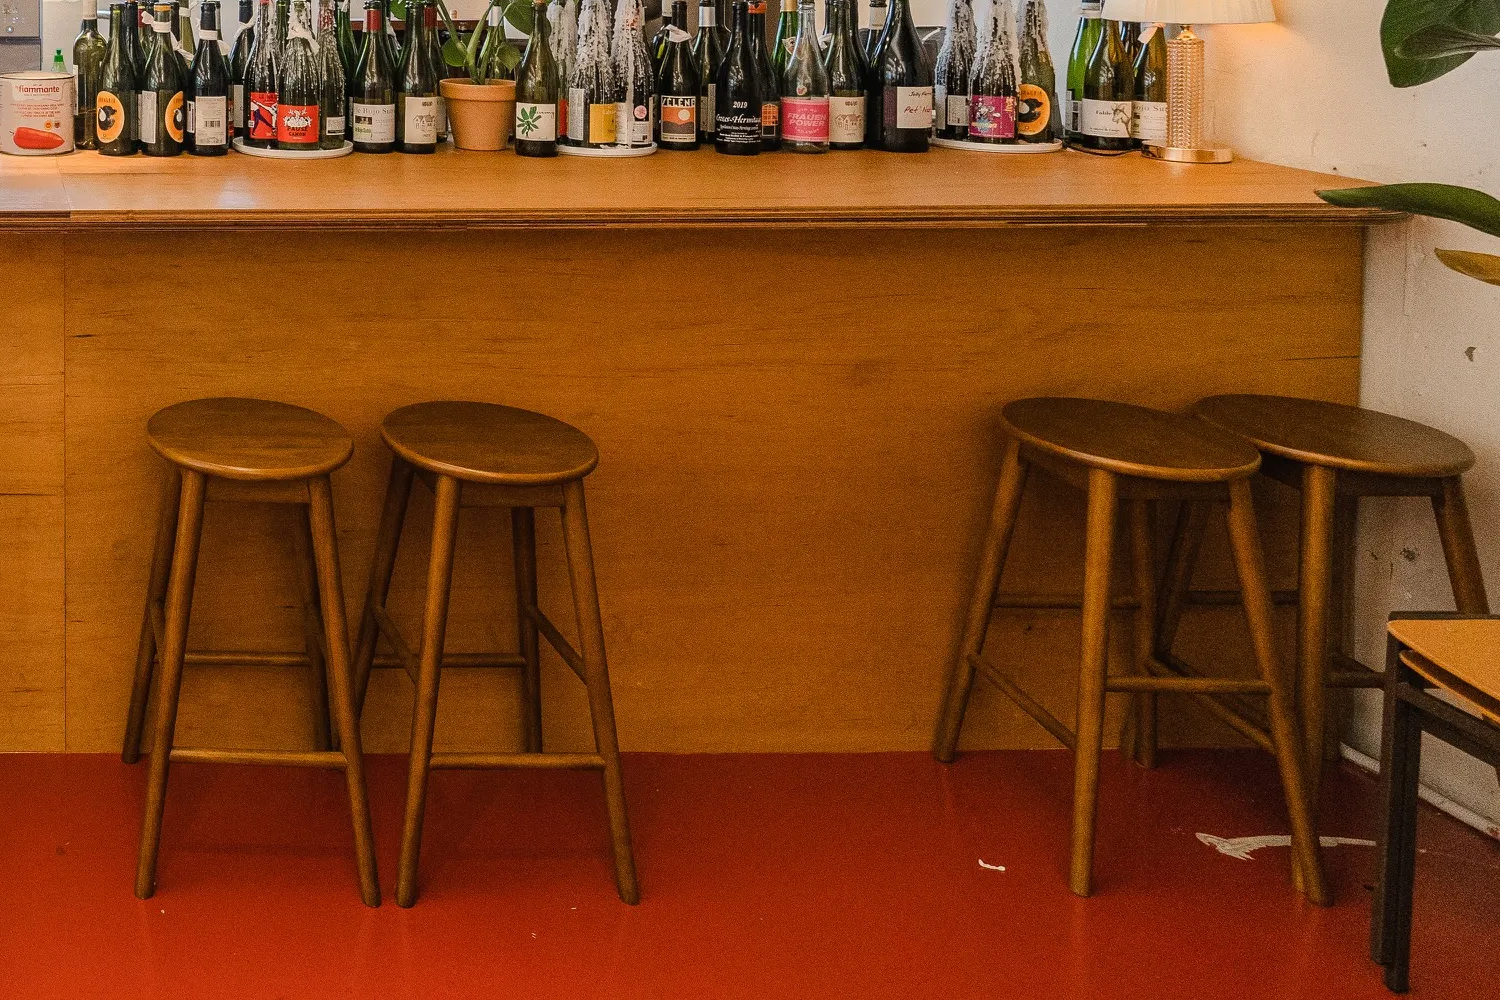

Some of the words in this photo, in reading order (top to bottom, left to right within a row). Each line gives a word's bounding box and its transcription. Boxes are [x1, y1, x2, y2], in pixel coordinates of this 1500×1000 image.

[19, 85, 60, 93] fiammante
[787, 112, 827, 121] FRAUEN
[789, 119, 825, 127] POWER
